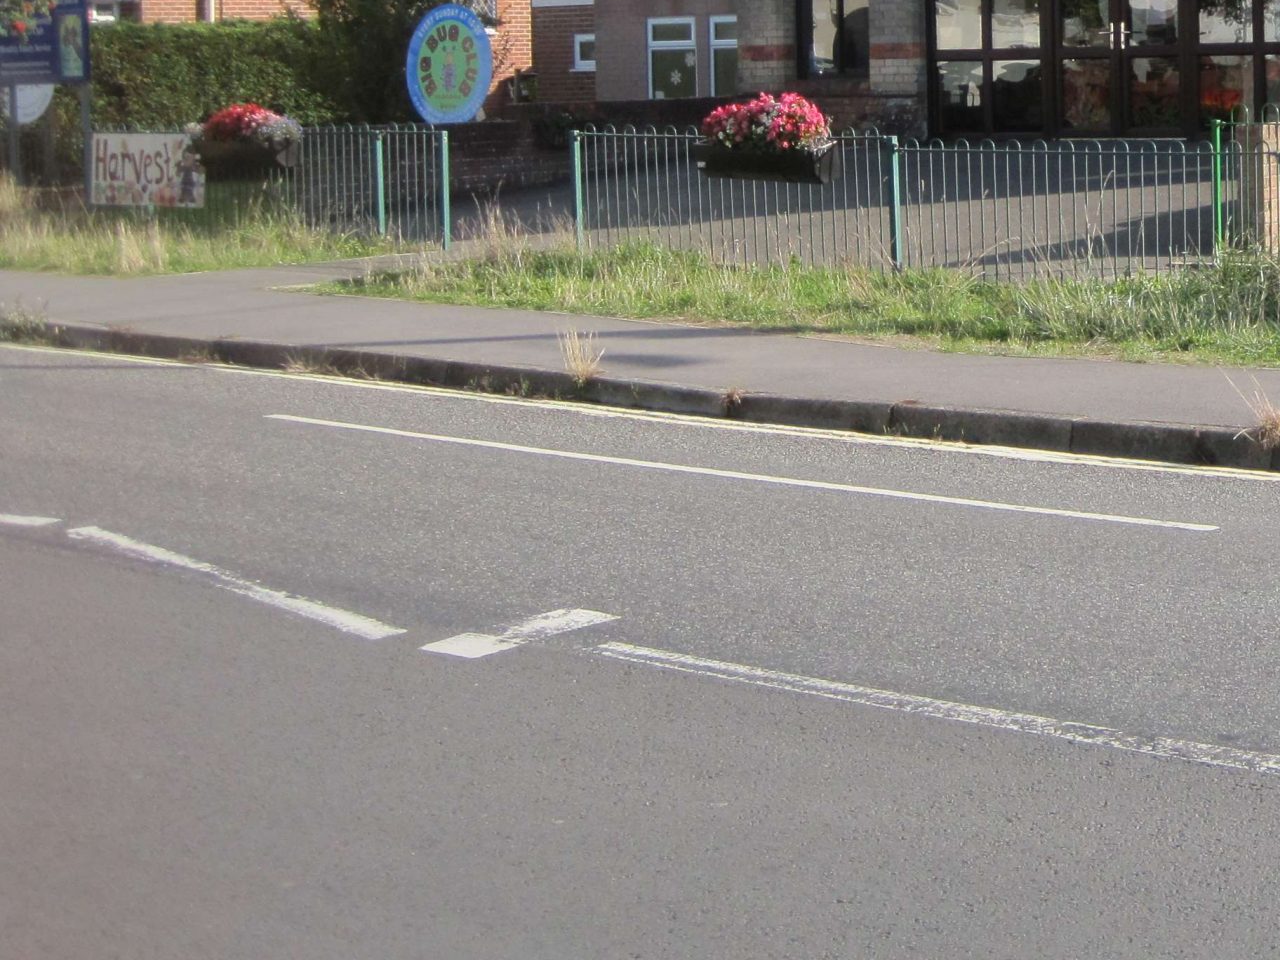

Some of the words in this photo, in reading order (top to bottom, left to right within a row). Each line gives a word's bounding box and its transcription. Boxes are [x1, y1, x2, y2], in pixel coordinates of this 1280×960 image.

[425, 24, 460, 53] BUG
[420, 56, 437, 97] BIG
[459, 36, 478, 97] CLUB
[95, 139, 174, 184] Harvest
